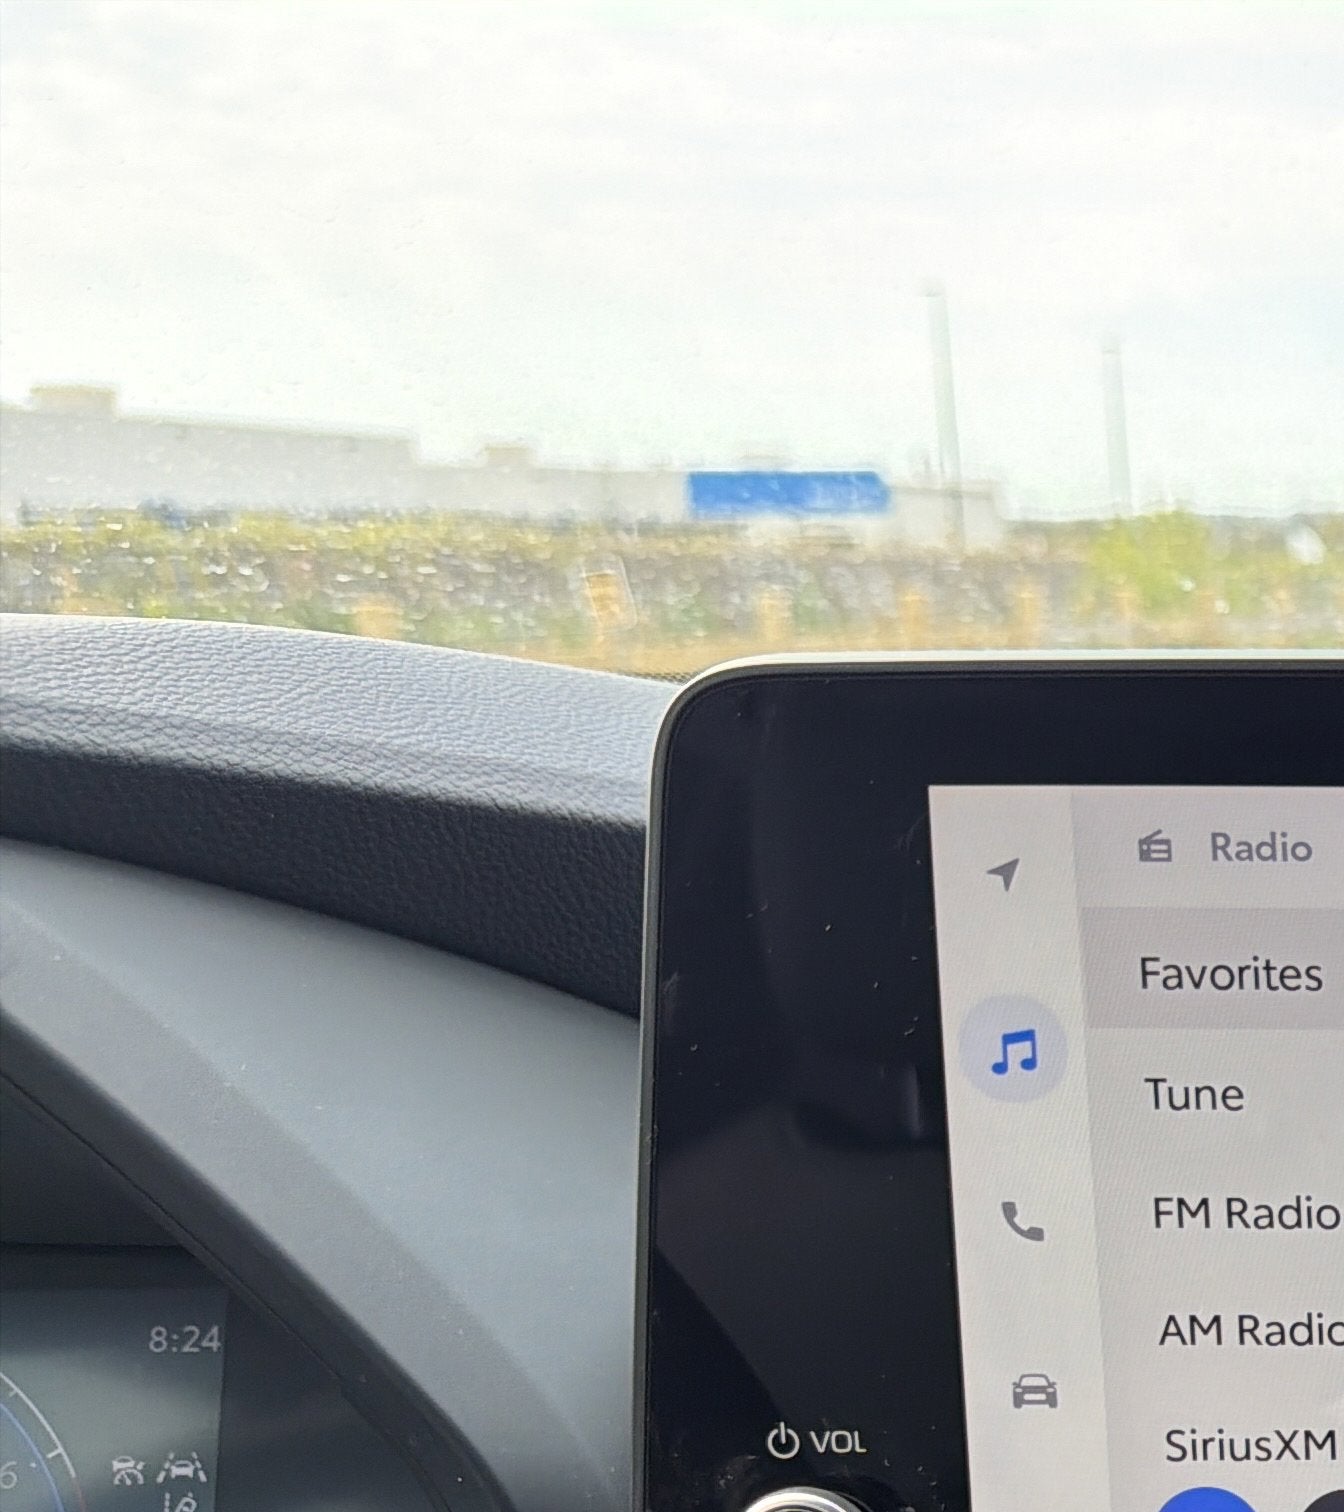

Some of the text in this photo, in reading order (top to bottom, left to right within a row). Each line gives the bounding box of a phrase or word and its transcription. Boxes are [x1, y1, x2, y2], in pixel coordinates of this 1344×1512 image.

[1209, 830, 1314, 864] Radio
[1140, 955, 1323, 992] Favorites
[1144, 1077, 1245, 1112] Tune
[1153, 1195, 1341, 1230] FM Radio
[149, 1325, 221, 1353] 8:24
[1158, 1314, 1223, 1346] AM
[809, 1430, 867, 1454] VOL
[1165, 1428, 1338, 1463] SiriusXM
